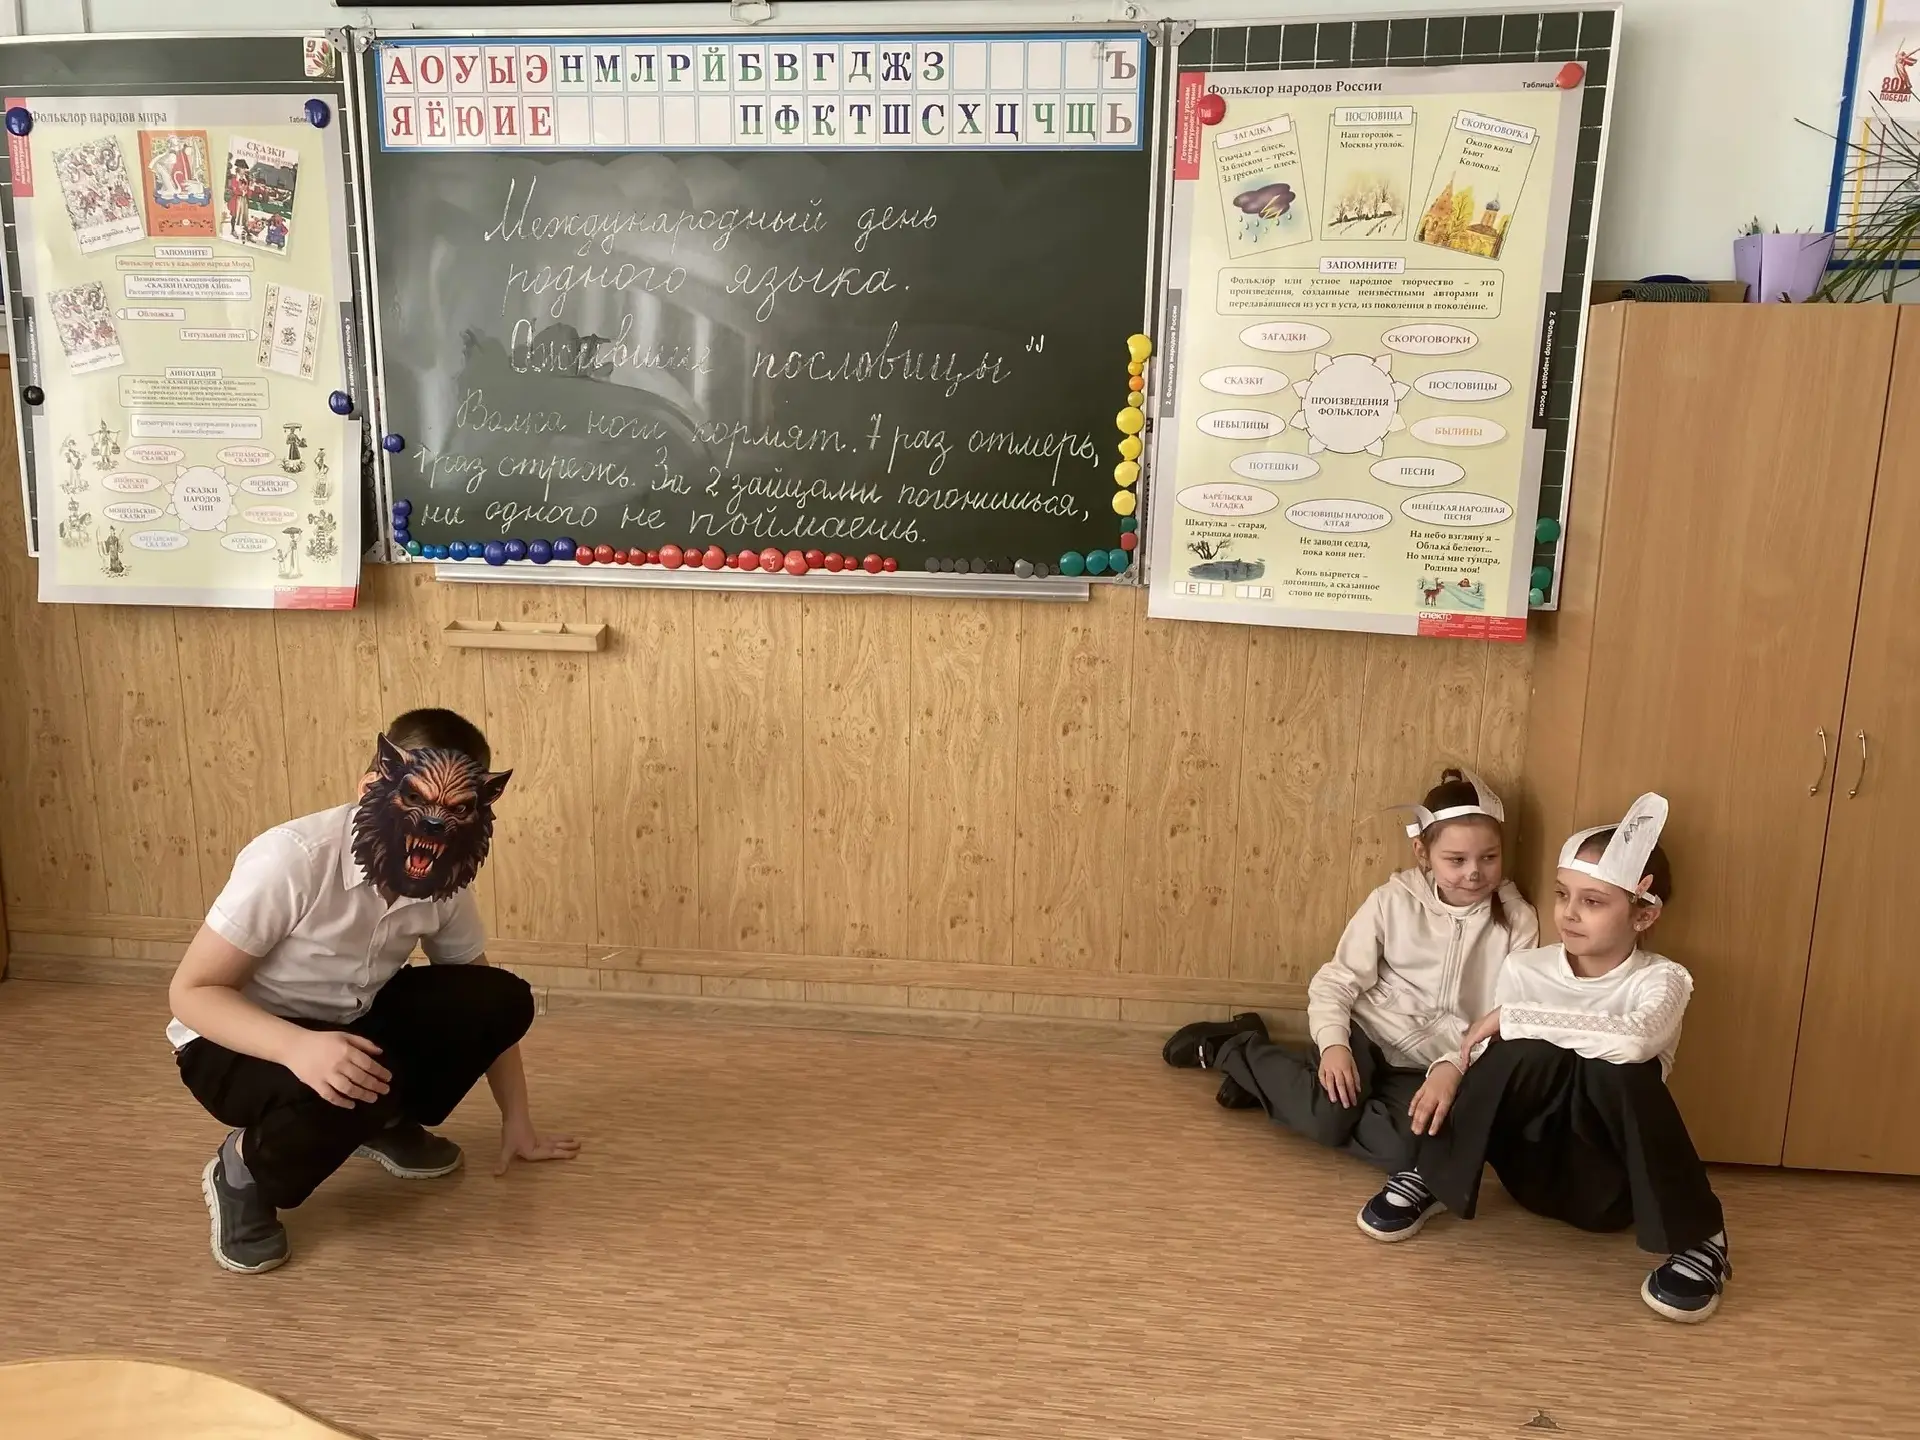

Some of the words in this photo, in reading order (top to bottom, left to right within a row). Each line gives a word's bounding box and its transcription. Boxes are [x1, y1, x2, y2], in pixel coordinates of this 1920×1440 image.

[386, 57, 412, 84] А
[420, 56, 444, 84] О
[453, 56, 478, 83] У
[489, 56, 516, 83] Ы
[526, 55, 548, 83] Э
[560, 55, 584, 82] Н
[594, 55, 621, 82] М
[630, 54, 656, 82] Л
[667, 54, 690, 82] Р
[702, 46, 726, 82] Й
[738, 54, 762, 81] Б
[774, 53, 799, 81] В
[813, 53, 835, 81] Г
[848, 52, 872, 83] Д
[881, 51, 912, 81] Ж
[923, 51, 945, 81] З
[1105, 50, 1136, 79] Ъ
[1207, 84, 1274, 97] Фольклор
[1277, 83, 1332, 97] народов
[1336, 81, 1382, 92] России
[1522, 81, 1554, 89] Таблица
[1882, 77, 1900, 91] 80
[1880, 93, 1911, 103] ПОБЕДА!
[90, 113, 135, 125] народов
[138, 113, 167, 126] мира
[391, 106, 413, 135] Я
[428, 101, 446, 137] Ё
[455, 106, 484, 136] Ю
[492, 106, 517, 136] И
[528, 106, 551, 136] Е
[740, 105, 763, 134] П
[774, 104, 800, 134] Ф
[812, 105, 836, 135] К
[849, 104, 872, 134] Т
[882, 104, 911, 134] Ш
[921, 104, 945, 135] С
[957, 103, 982, 134] Х
[995, 103, 1019, 141] Ц
[1032, 103, 1056, 134] Ч
[1065, 103, 1096, 141] Щ
[1106, 103, 1132, 133] Ь
[1345, 111, 1403, 122] ПОСЛОВИЦА
[1233, 125, 1272, 141] ЗАГАДКА
[1461, 117, 1529, 140] СКОРОГОВОРКА
[246, 141, 287, 158] СКАЗКИ
[484, 175, 827, 256] Международный
[856, 206, 939, 253] день
[1326, 261, 1398, 270] ЗАПОМНИТЕ!
[500, 263, 688, 318] родного
[726, 263, 911, 322] языка.
[1261, 333, 1307, 342] ЗАГАДКИ
[1388, 334, 1471, 344] СКОРОГОВОРКИ
[751, 321, 1012, 397] пословицы
[1224, 376, 1263, 385] СКАЗКИ
[1428, 381, 1498, 391] ПОСЛОВИЦЫ
[1311, 397, 1389, 407] ПРОИЗВЕДЕНИЯ
[1318, 407, 1380, 417] ФОЛЬКЛОРА
[1213, 419, 1269, 430] НЕБЫЛИЦЫ
[456, 388, 567, 433] Волка
[588, 410, 668, 441] ноги
[887, 425, 955, 476] раз
[1434, 427, 1483, 436] БЫЛИНЫ
[1249, 462, 1299, 471] ПОТЕШКИ
[1400, 467, 1435, 477] ПЕСНИ
[705, 467, 721, 497] 2
[185, 486, 218, 494] СКАЗКИ
[420, 502, 466, 528] ни
[485, 501, 598, 535] одного
[620, 502, 666, 530] не
[1443, 513, 1472, 521] ПЕСНЯ
[1410, 530, 1422, 538] На
